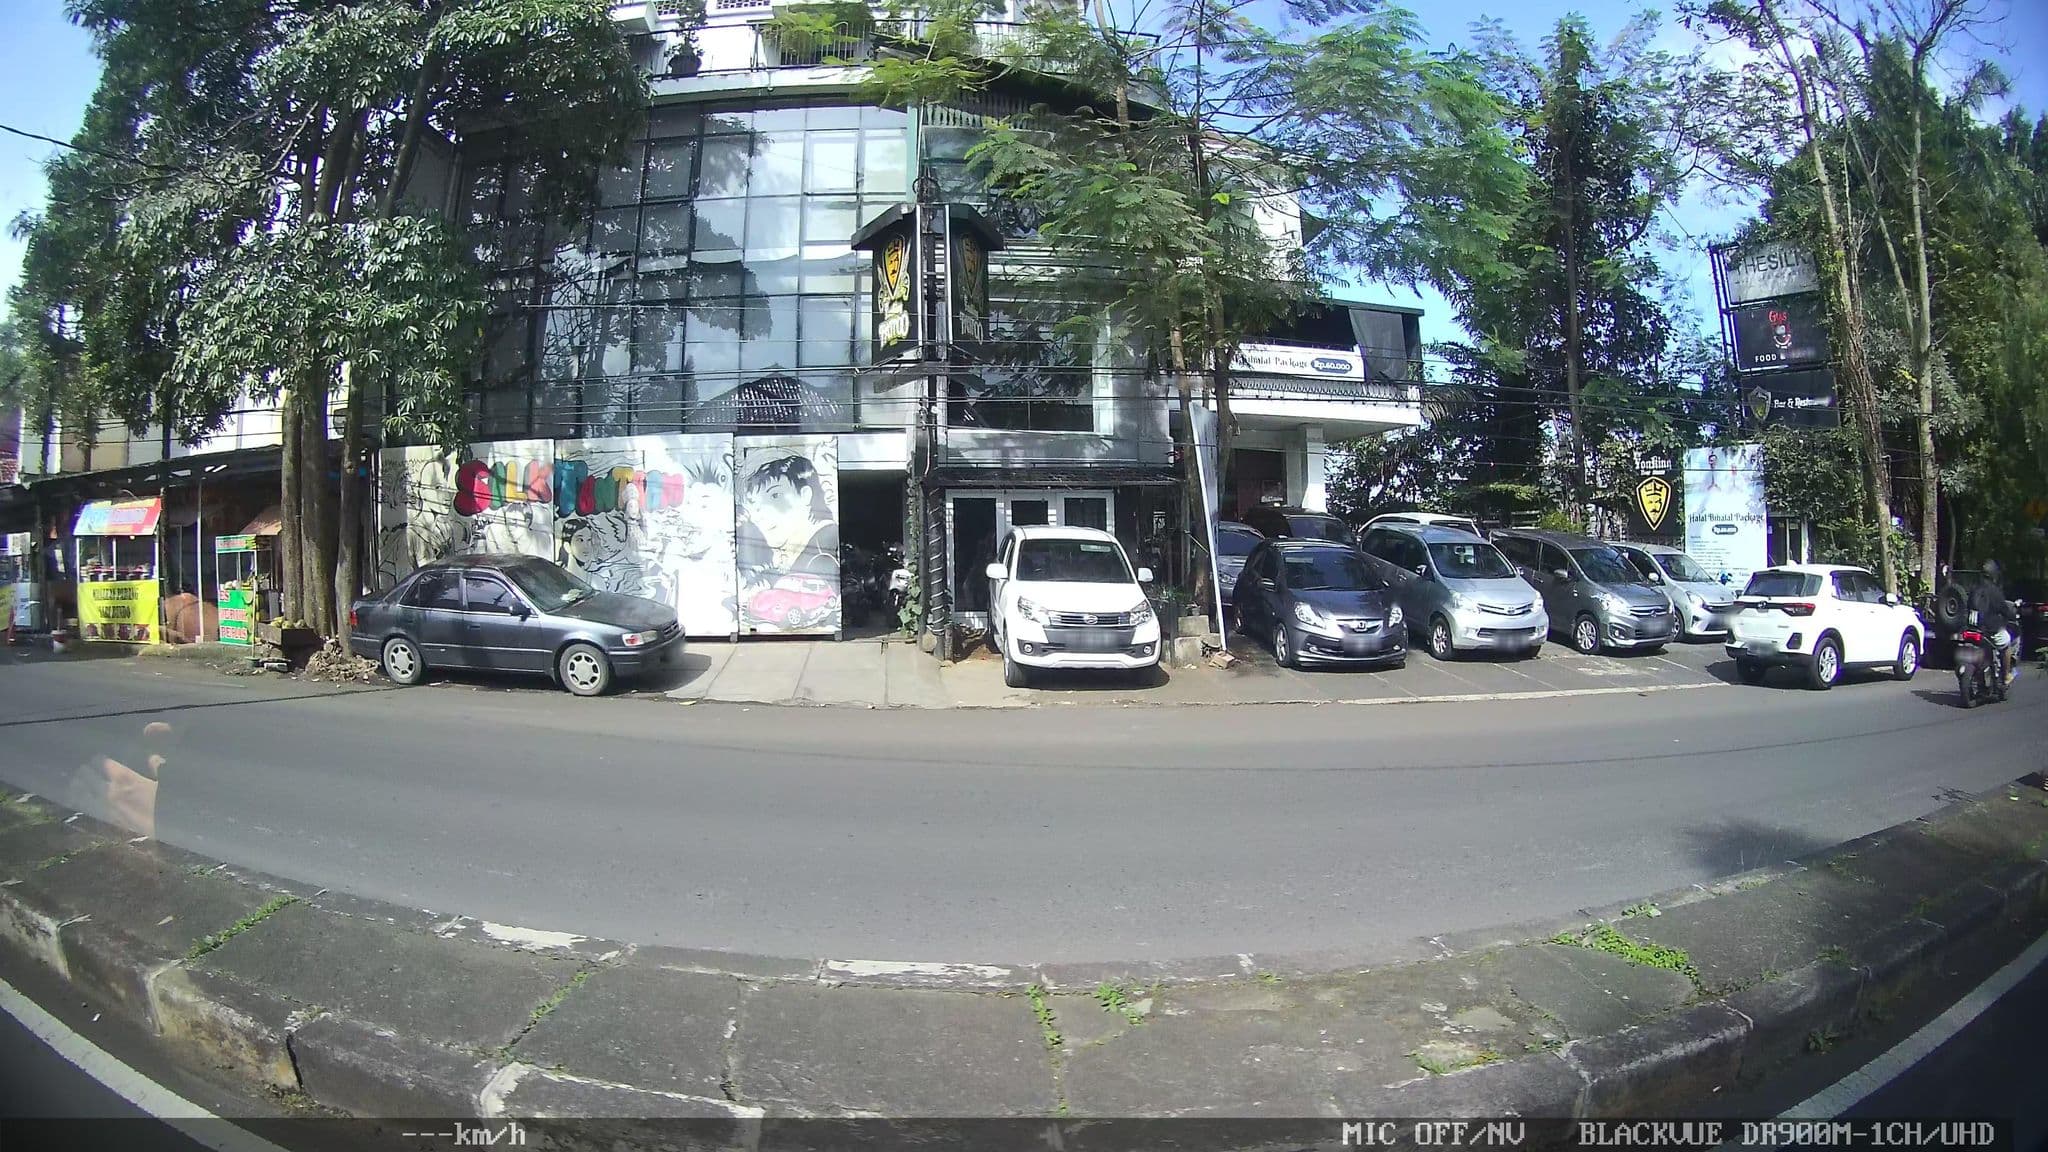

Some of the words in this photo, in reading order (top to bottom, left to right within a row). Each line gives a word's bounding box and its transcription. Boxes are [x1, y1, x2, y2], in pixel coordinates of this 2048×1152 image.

[1275, 356, 1308, 369] Package
[1755, 354, 1777, 362] FOOD
[1689, 512, 1707, 523] Halal
[1734, 512, 1765, 524] Package
